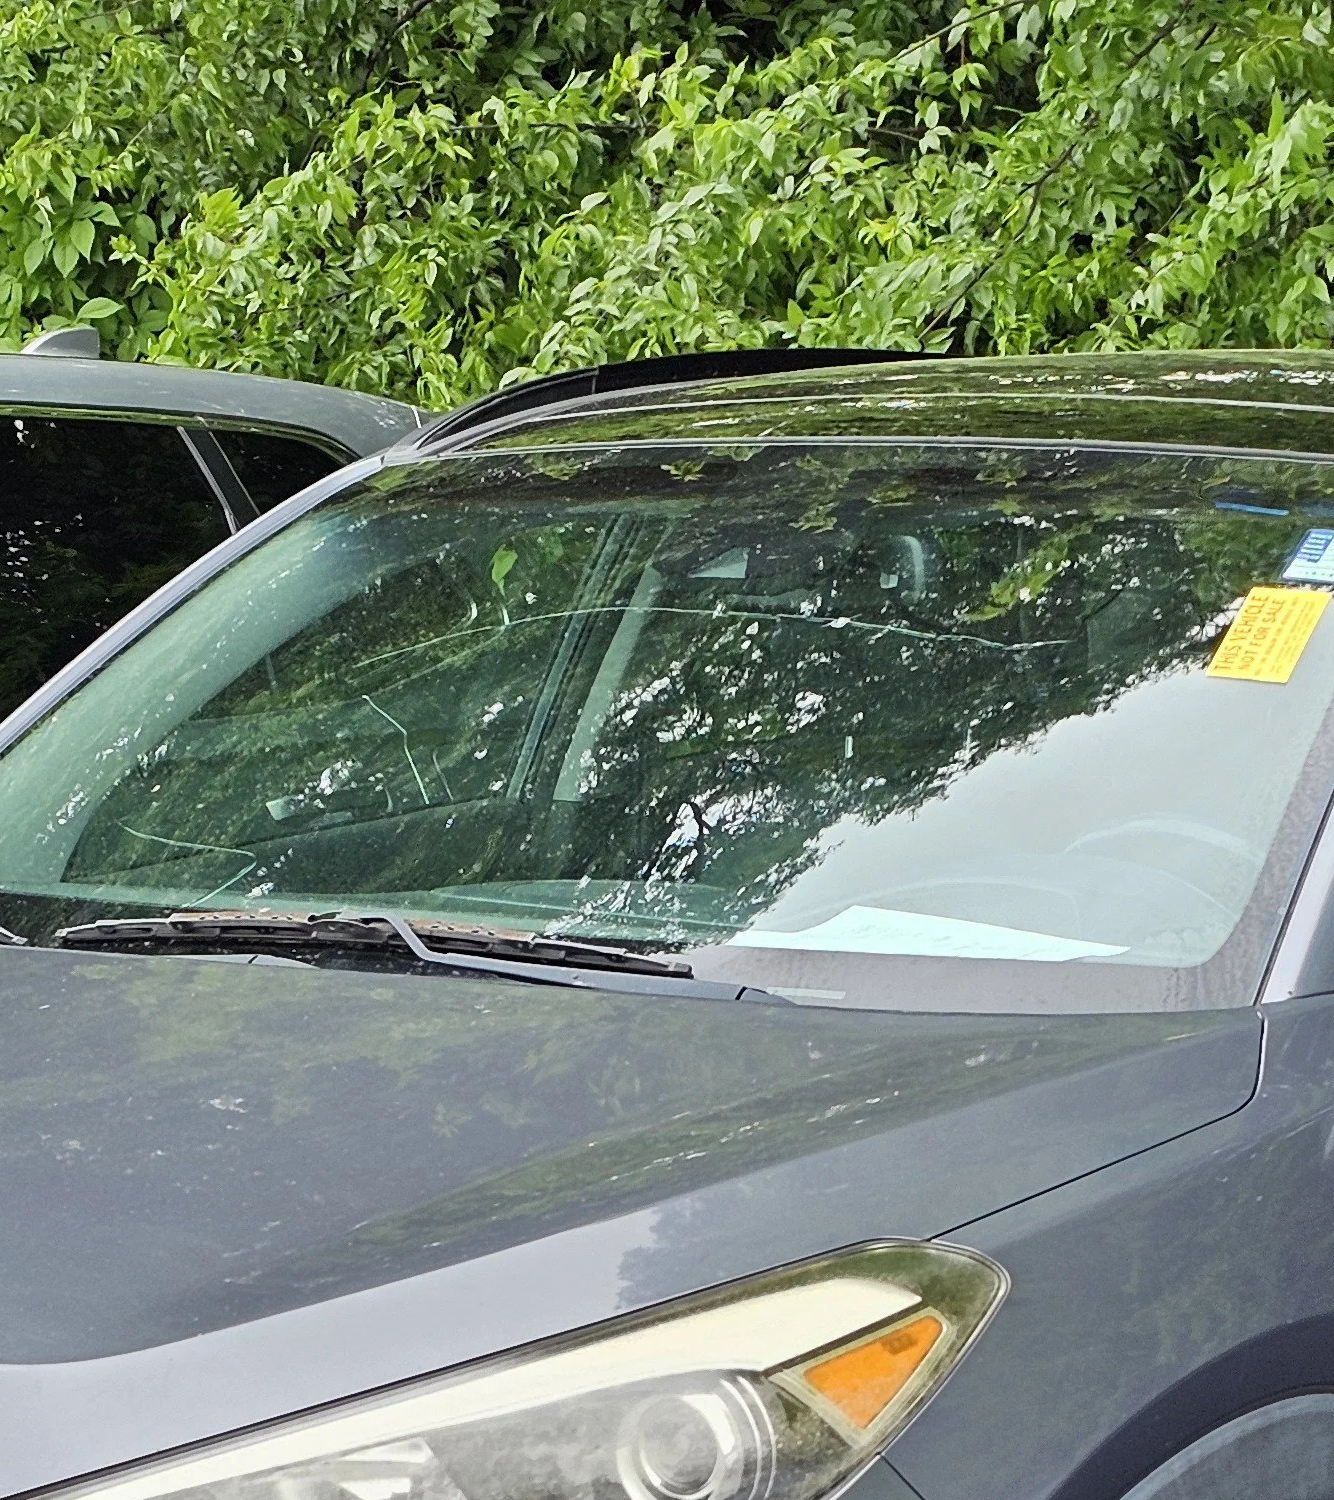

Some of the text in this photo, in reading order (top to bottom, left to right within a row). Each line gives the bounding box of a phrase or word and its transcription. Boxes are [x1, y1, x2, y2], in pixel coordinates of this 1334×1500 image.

[1214, 595, 1270, 671] THIS VEHICLE
[1239, 598, 1286, 671] NOT FOR SALE
